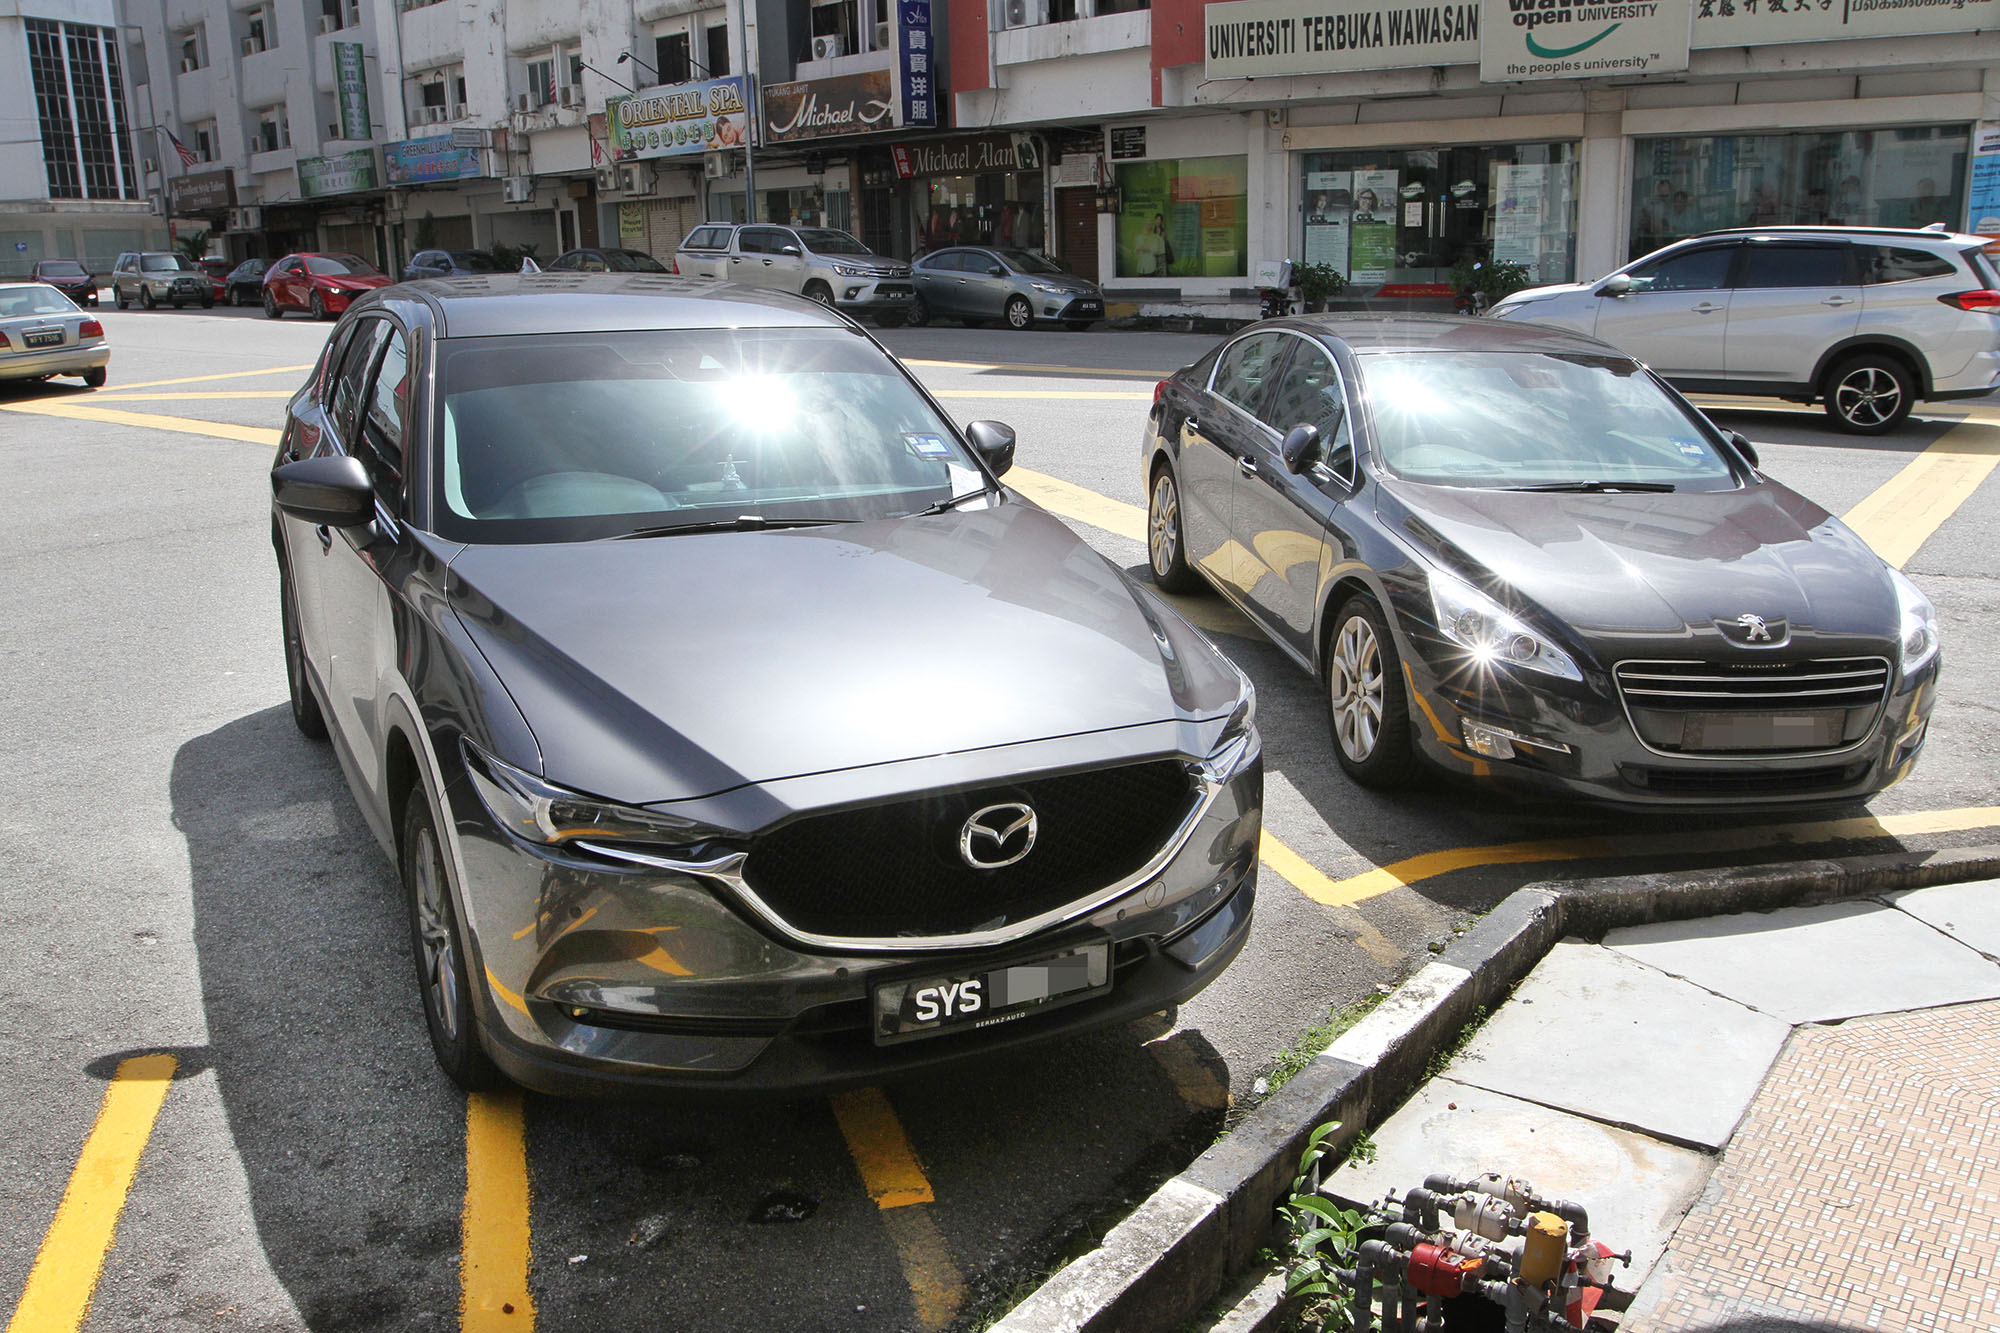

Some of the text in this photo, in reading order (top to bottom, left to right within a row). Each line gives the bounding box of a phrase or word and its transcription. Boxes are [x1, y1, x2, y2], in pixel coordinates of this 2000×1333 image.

[1209, 4, 1479, 59] UNIVERSITI TERBUKA WAWASAN
[1513, 3, 1658, 30] open UNIVERSITY
[1507, 63, 1527, 75] the
[619, 82, 744, 129] ORIENTAL SPA
[770, 93, 855, 133] Michael
[913, 142, 1014, 175] Michael Alan
[916, 980, 981, 1021] SYS
